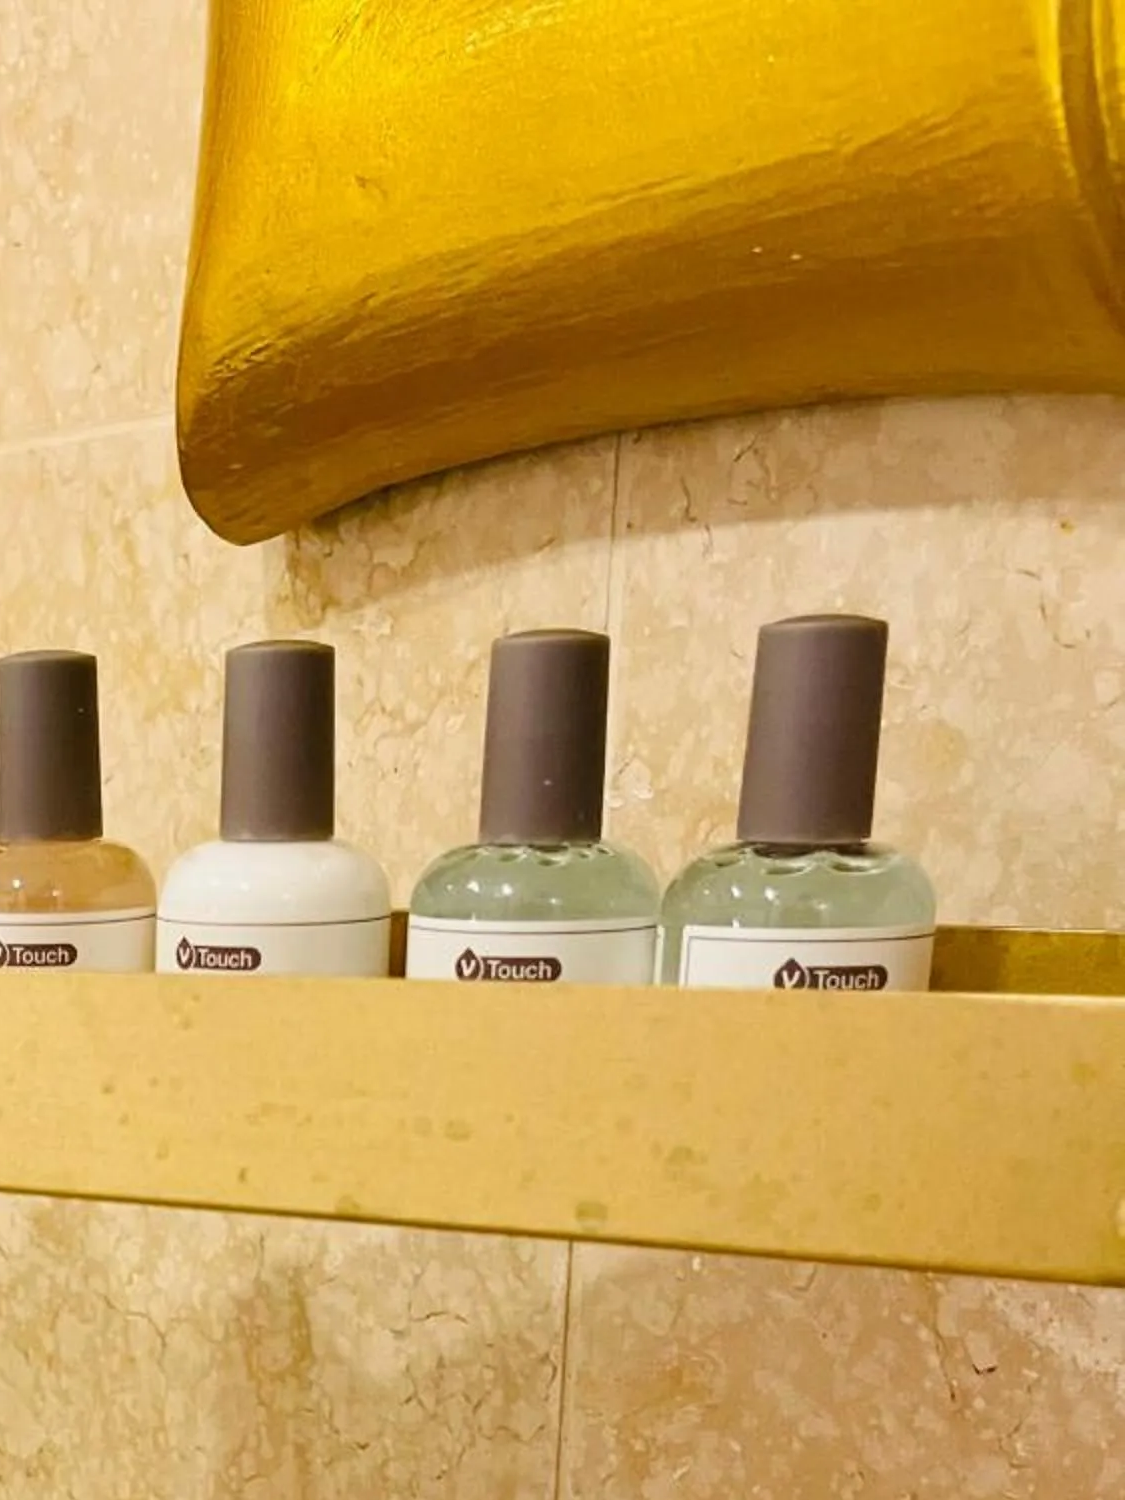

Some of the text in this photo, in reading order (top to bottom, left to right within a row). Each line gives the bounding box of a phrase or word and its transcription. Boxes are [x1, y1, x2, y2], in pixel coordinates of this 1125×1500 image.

[12, 946, 70, 965] Touch
[198, 948, 253, 969] Touch
[487, 959, 552, 980] Touch
[814, 969, 880, 989] Touch
